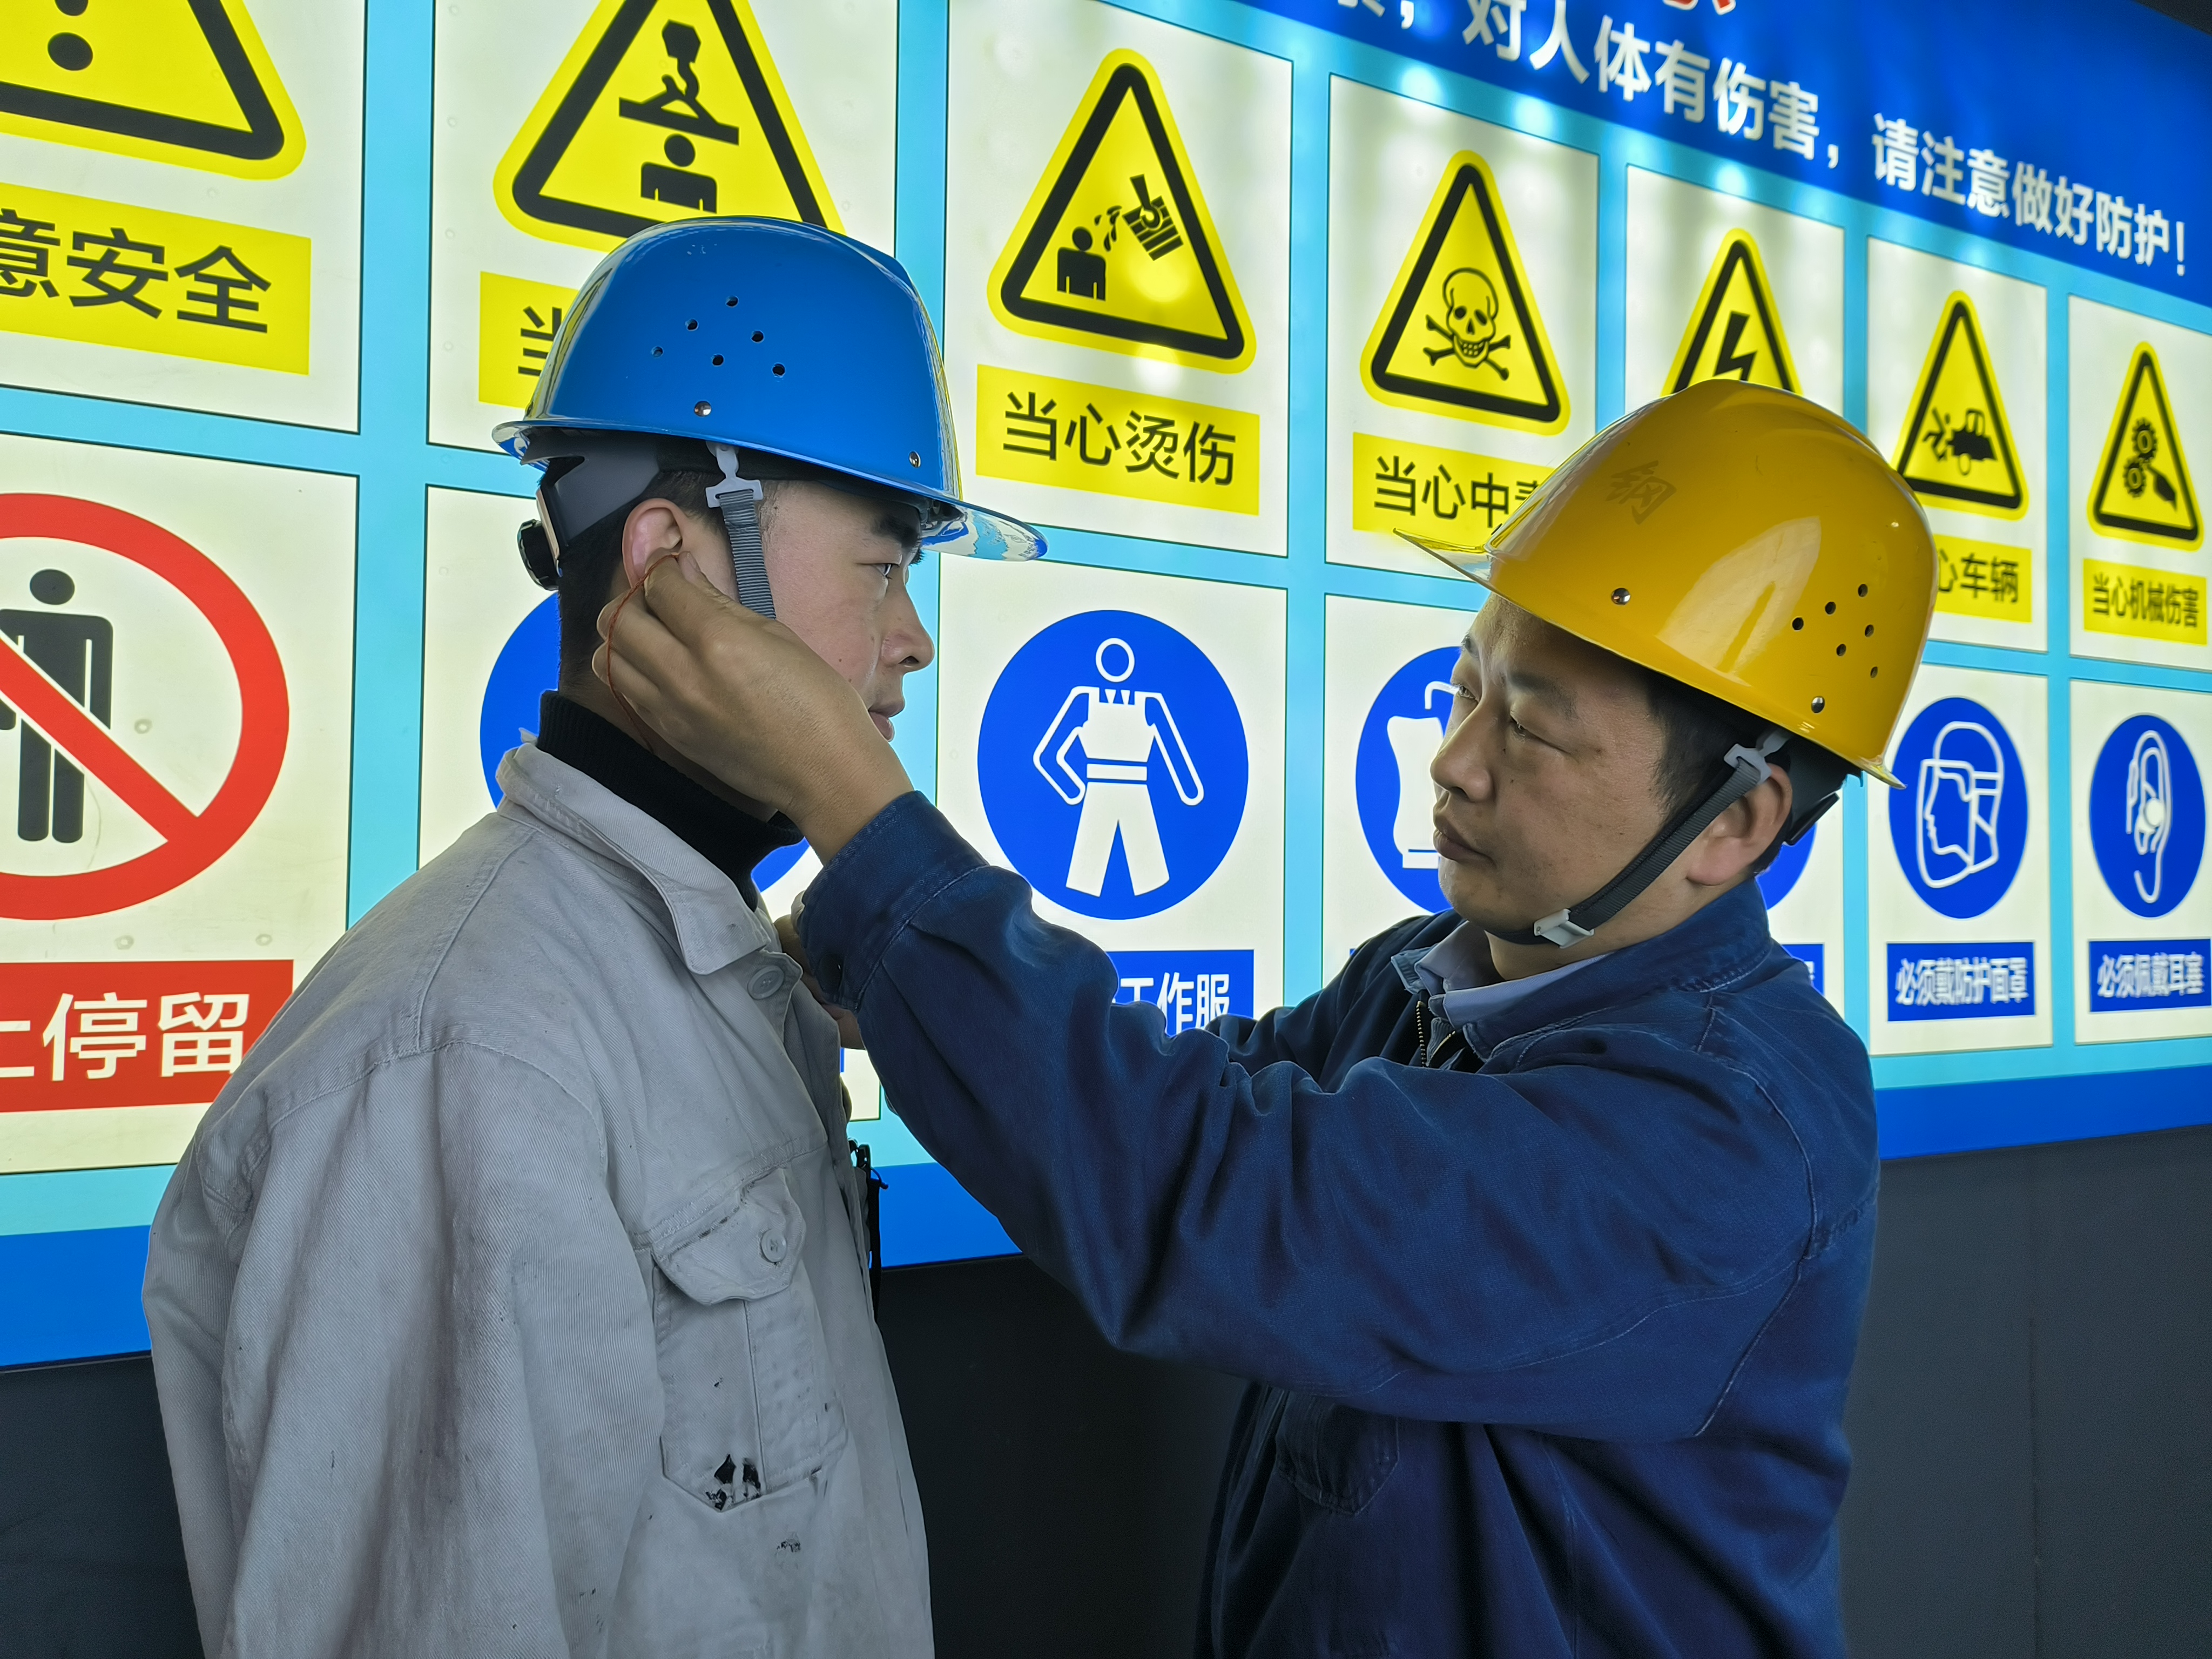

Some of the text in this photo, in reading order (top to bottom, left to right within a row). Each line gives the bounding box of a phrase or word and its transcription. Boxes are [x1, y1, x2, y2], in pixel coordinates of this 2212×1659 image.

[1337, 0, 2185, 276] ，对人体有伤害，请注意做好防护！
[0, 208, 271, 333] 意安全
[1003, 392, 1236, 485] 当心烫伤
[1938, 548, 2019, 604] 心车辆
[2093, 571, 2199, 628] 当心机械伤害
[1895, 956, 2029, 1006] 必须戴防护面罩
[2096, 951, 2205, 998] 必须佩戴耳塞
